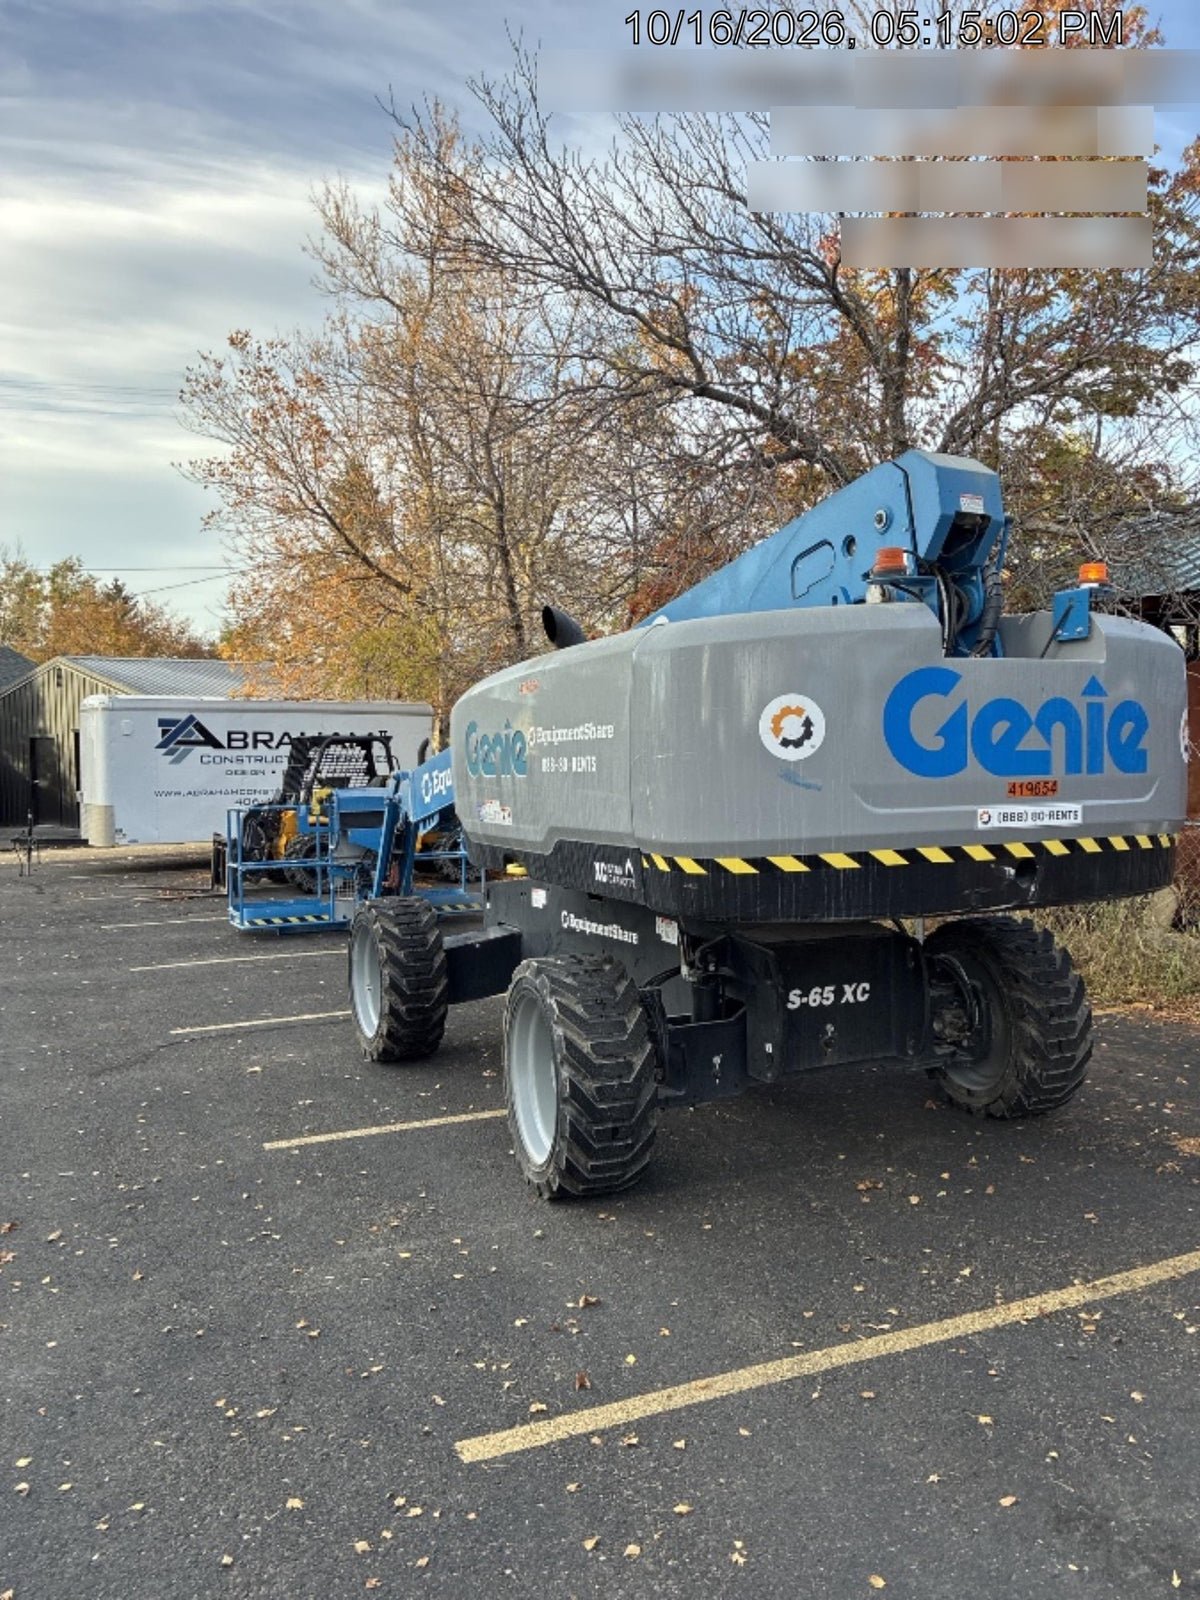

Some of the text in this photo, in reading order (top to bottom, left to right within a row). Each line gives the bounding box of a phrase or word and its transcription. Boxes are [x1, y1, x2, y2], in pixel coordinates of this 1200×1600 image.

[536, 722, 615, 746] EquipmentShare
[883, 666, 1149, 778] Genie
[464, 718, 529, 779] Genie
[1007, 780, 1058, 797] 419654
[786, 982, 870, 1010] S-65 XC
